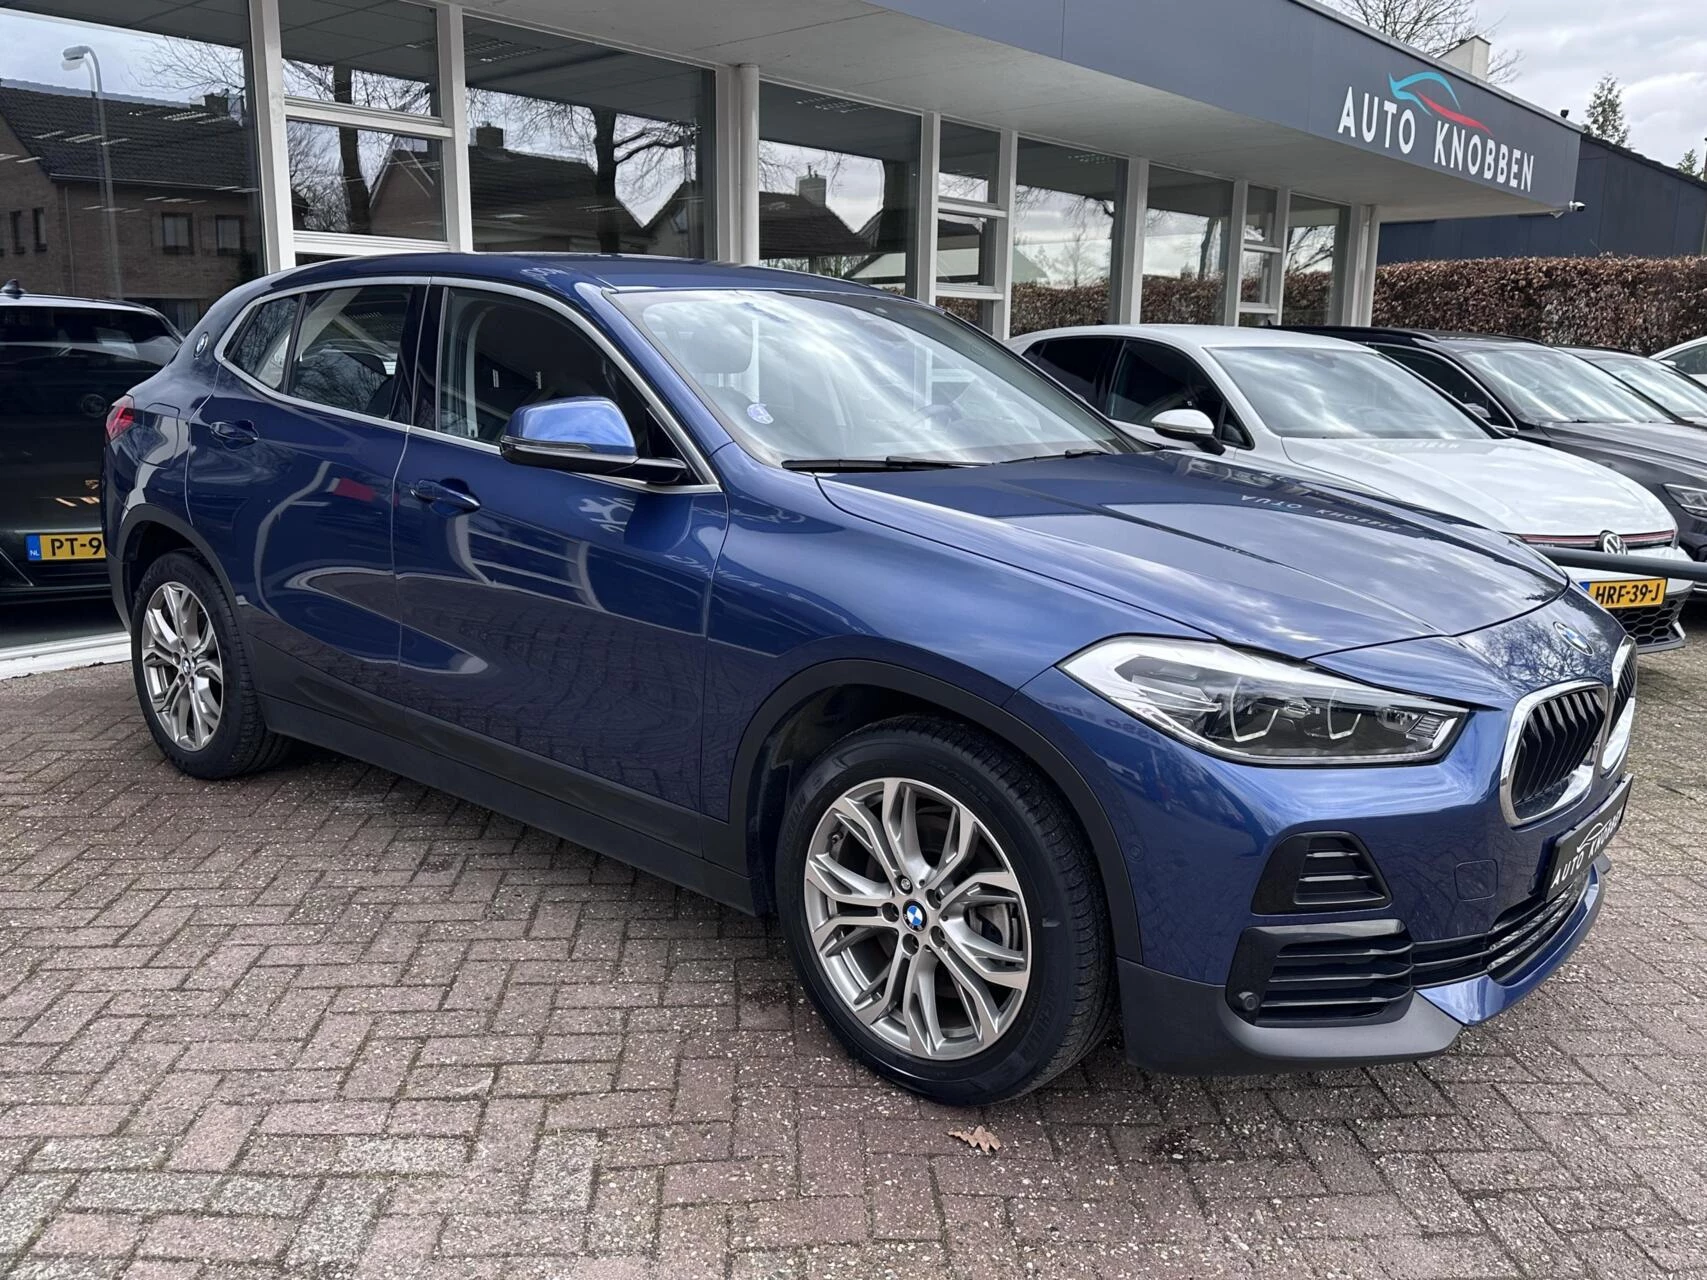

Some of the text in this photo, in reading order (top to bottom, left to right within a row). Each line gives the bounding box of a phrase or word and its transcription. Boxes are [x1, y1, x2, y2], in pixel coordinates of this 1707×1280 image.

[1337, 86, 1535, 193] AUTO KNOBBEN
[50, 537, 102, 556] PT-9
[1595, 582, 1661, 606] HRF-39-J
[1550, 850, 1585, 889] AUTO
